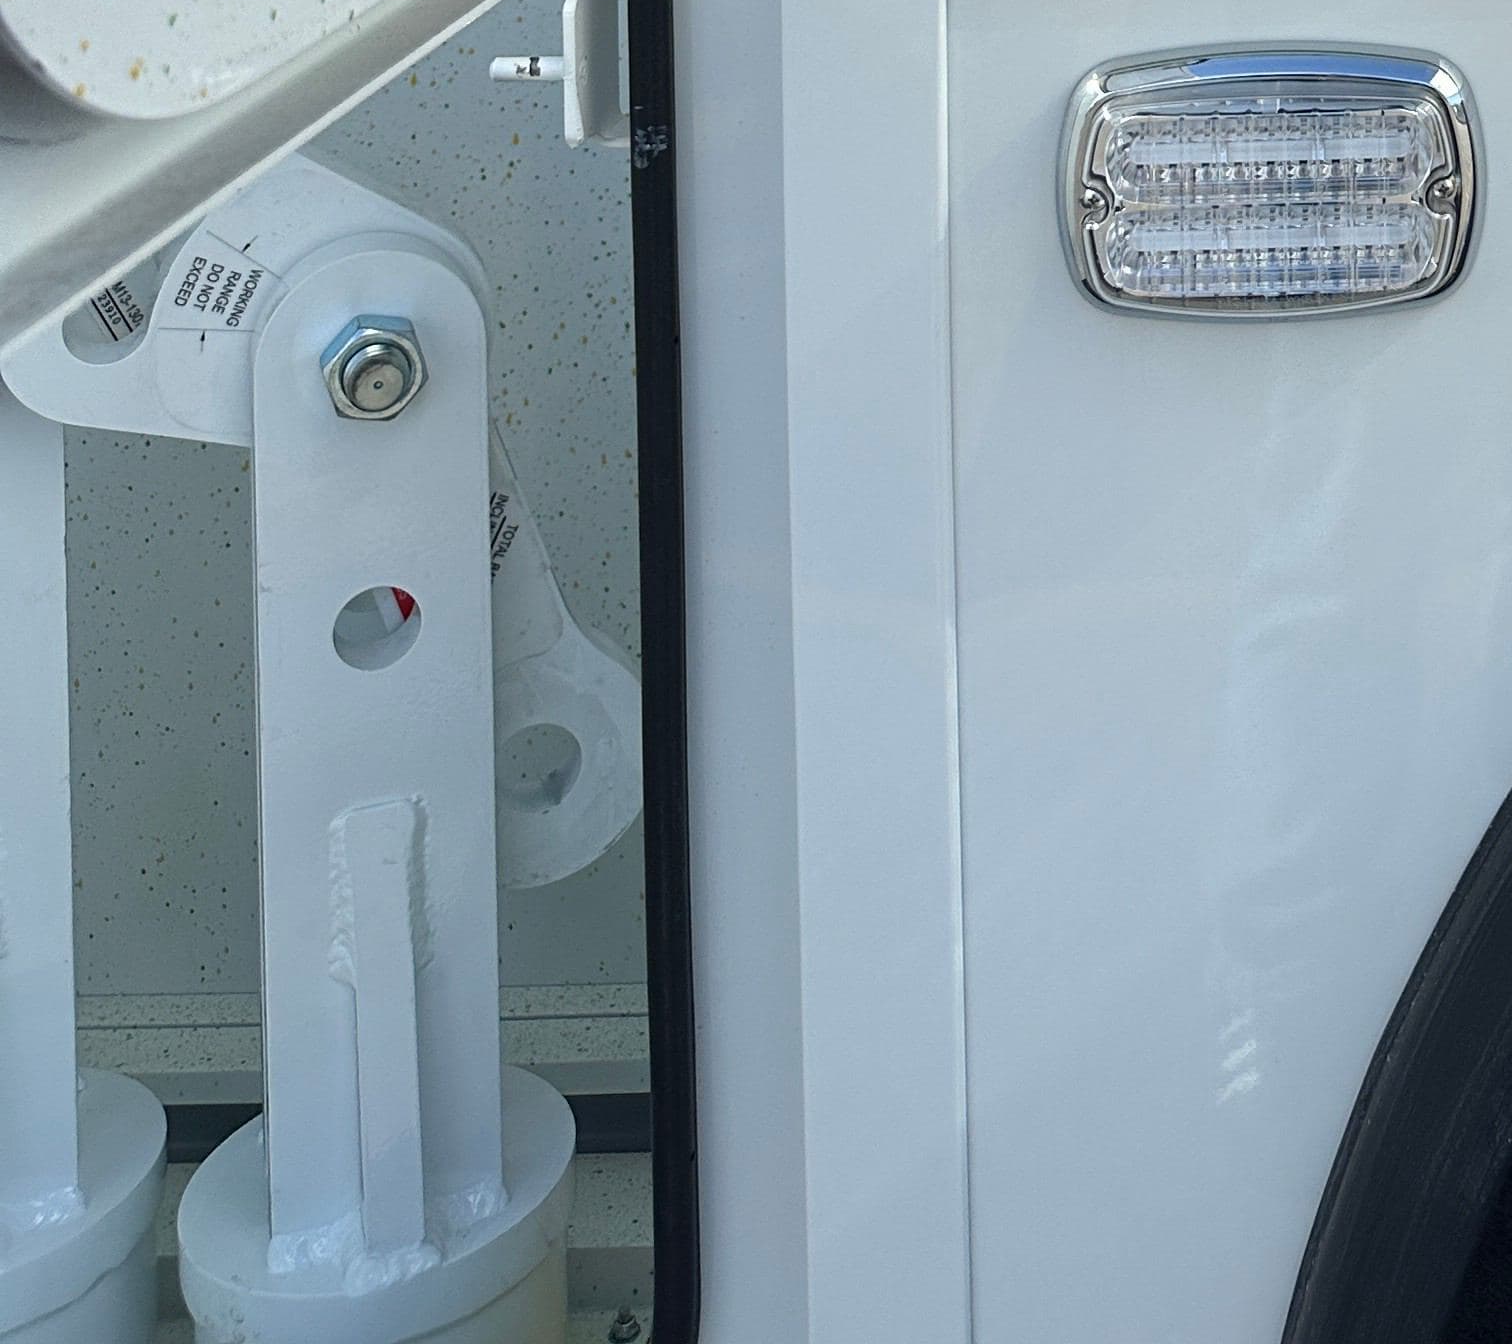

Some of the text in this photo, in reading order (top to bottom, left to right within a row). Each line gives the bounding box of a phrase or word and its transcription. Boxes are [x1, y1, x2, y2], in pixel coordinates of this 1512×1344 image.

[111, 280, 144, 328] M13-130
[174, 256, 207, 307] EXCEED
[193, 263, 224, 312] DO NOT
[211, 270, 242, 315] RANGE
[226, 268, 264, 328] WORKING
[97, 293, 121, 325] 23910
[492, 524, 519, 561] TOTAL
